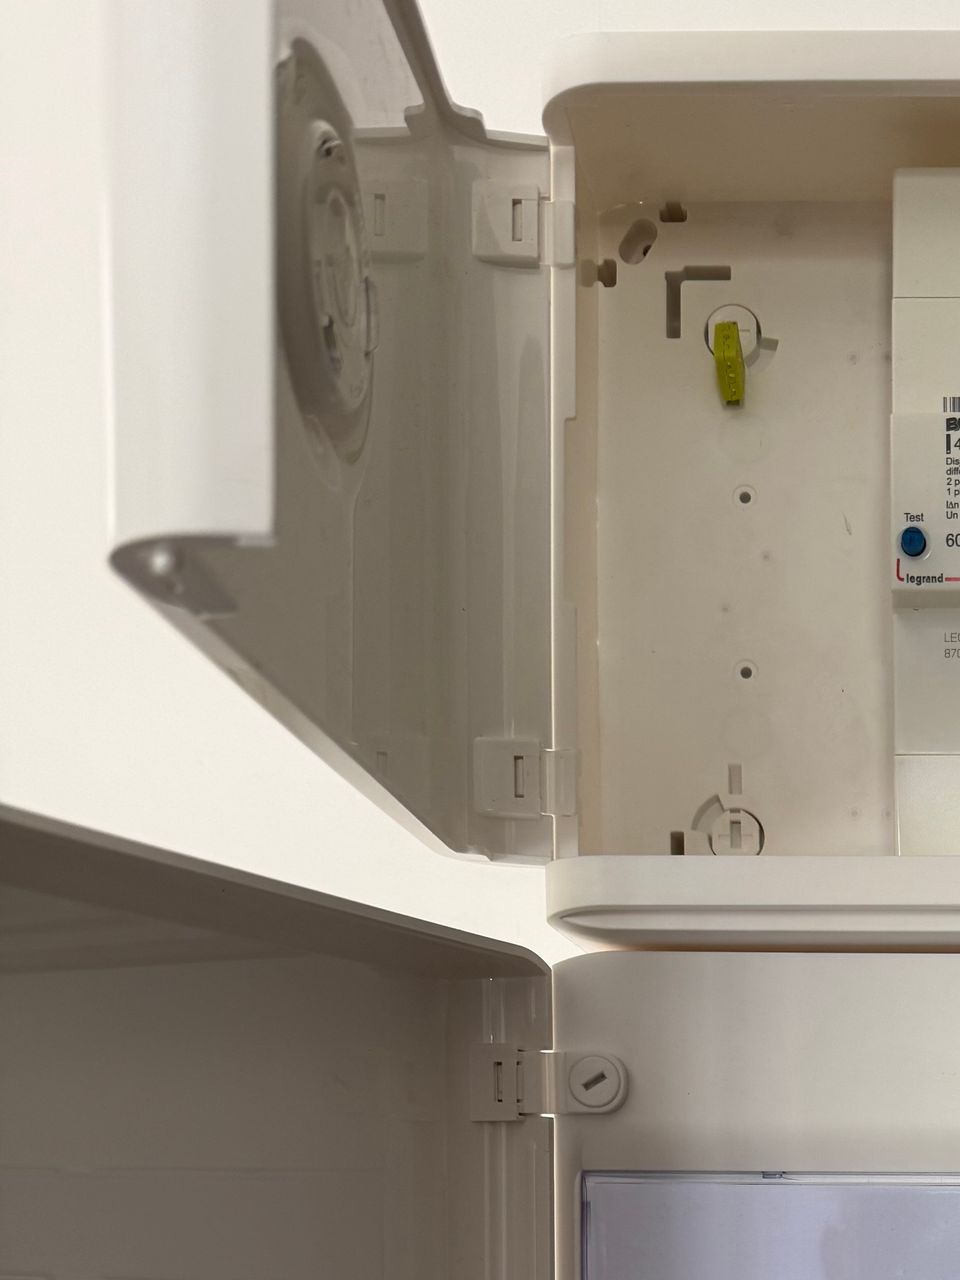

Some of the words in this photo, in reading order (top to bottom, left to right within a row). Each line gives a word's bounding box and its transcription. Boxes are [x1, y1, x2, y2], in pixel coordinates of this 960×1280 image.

[946, 477, 952, 486] 2
[946, 488, 951, 496] 1
[904, 512, 924, 523] Test
[946, 511, 958, 520] Un
[906, 573, 944, 585] legrand
